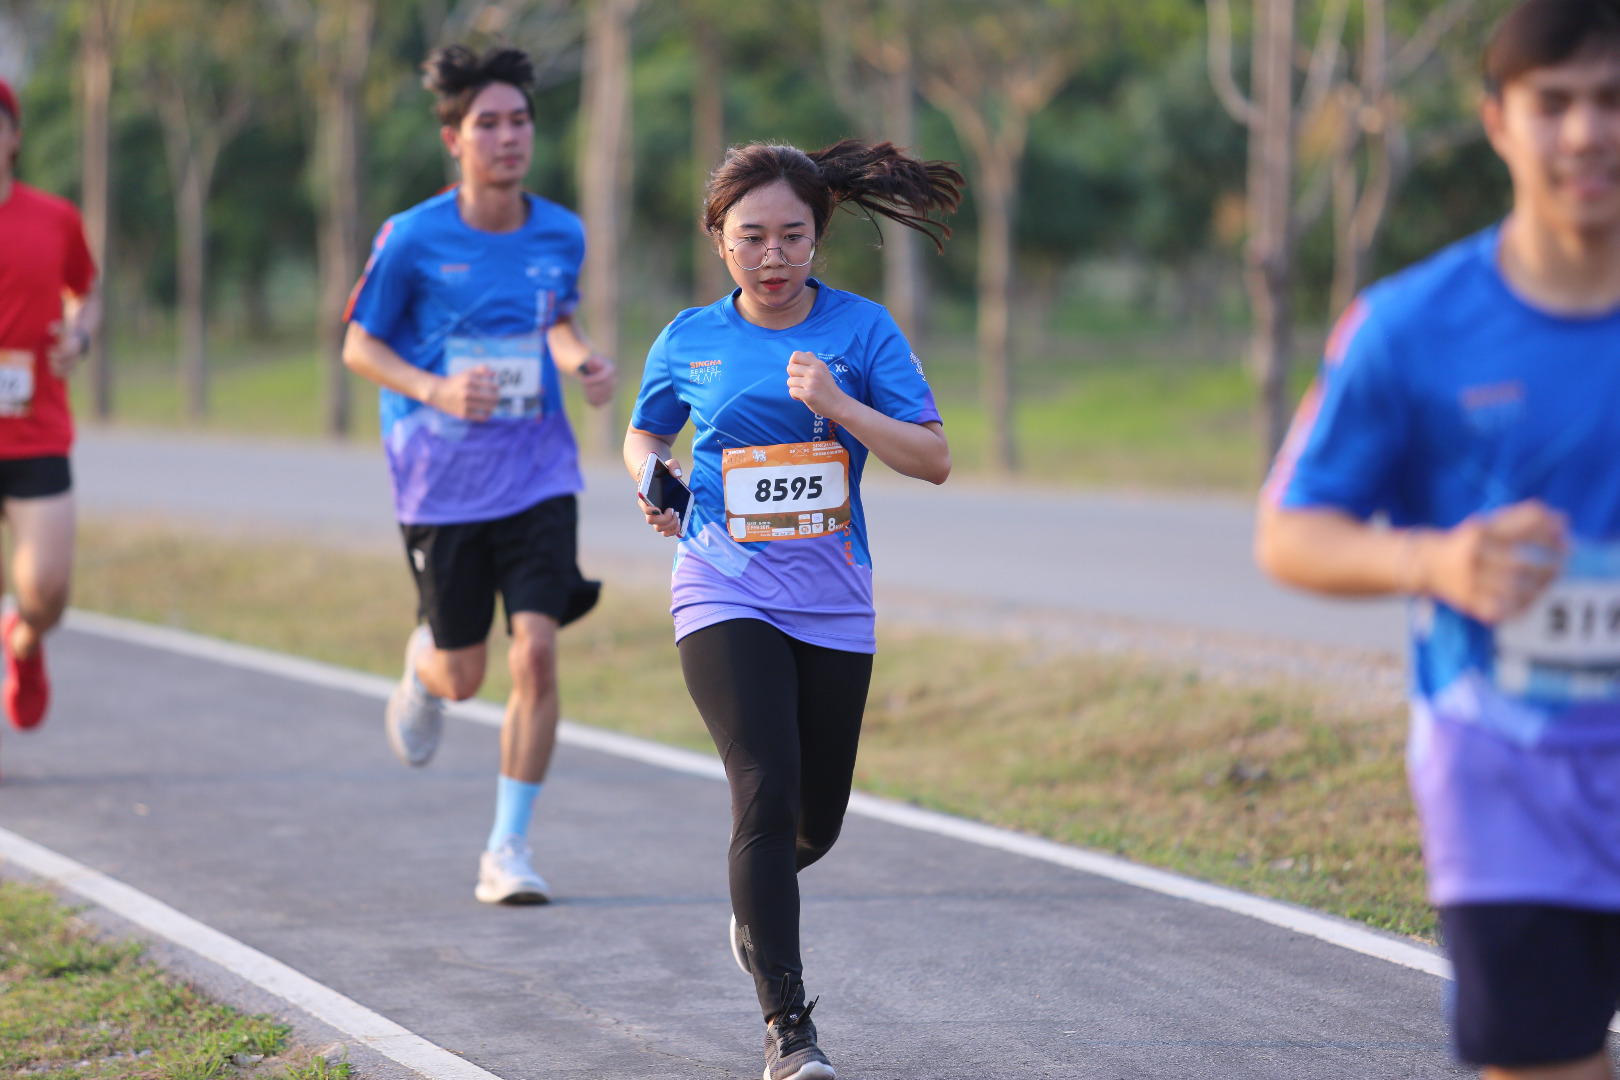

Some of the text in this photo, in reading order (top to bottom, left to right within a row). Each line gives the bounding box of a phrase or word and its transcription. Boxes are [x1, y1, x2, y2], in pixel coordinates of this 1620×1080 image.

[690, 360, 722, 369] SINGHA
[834, 363, 849, 373] XC
[754, 475, 823, 503] 8595
[827, 517, 836, 532] 8
[844, 541, 854, 566] RAI
